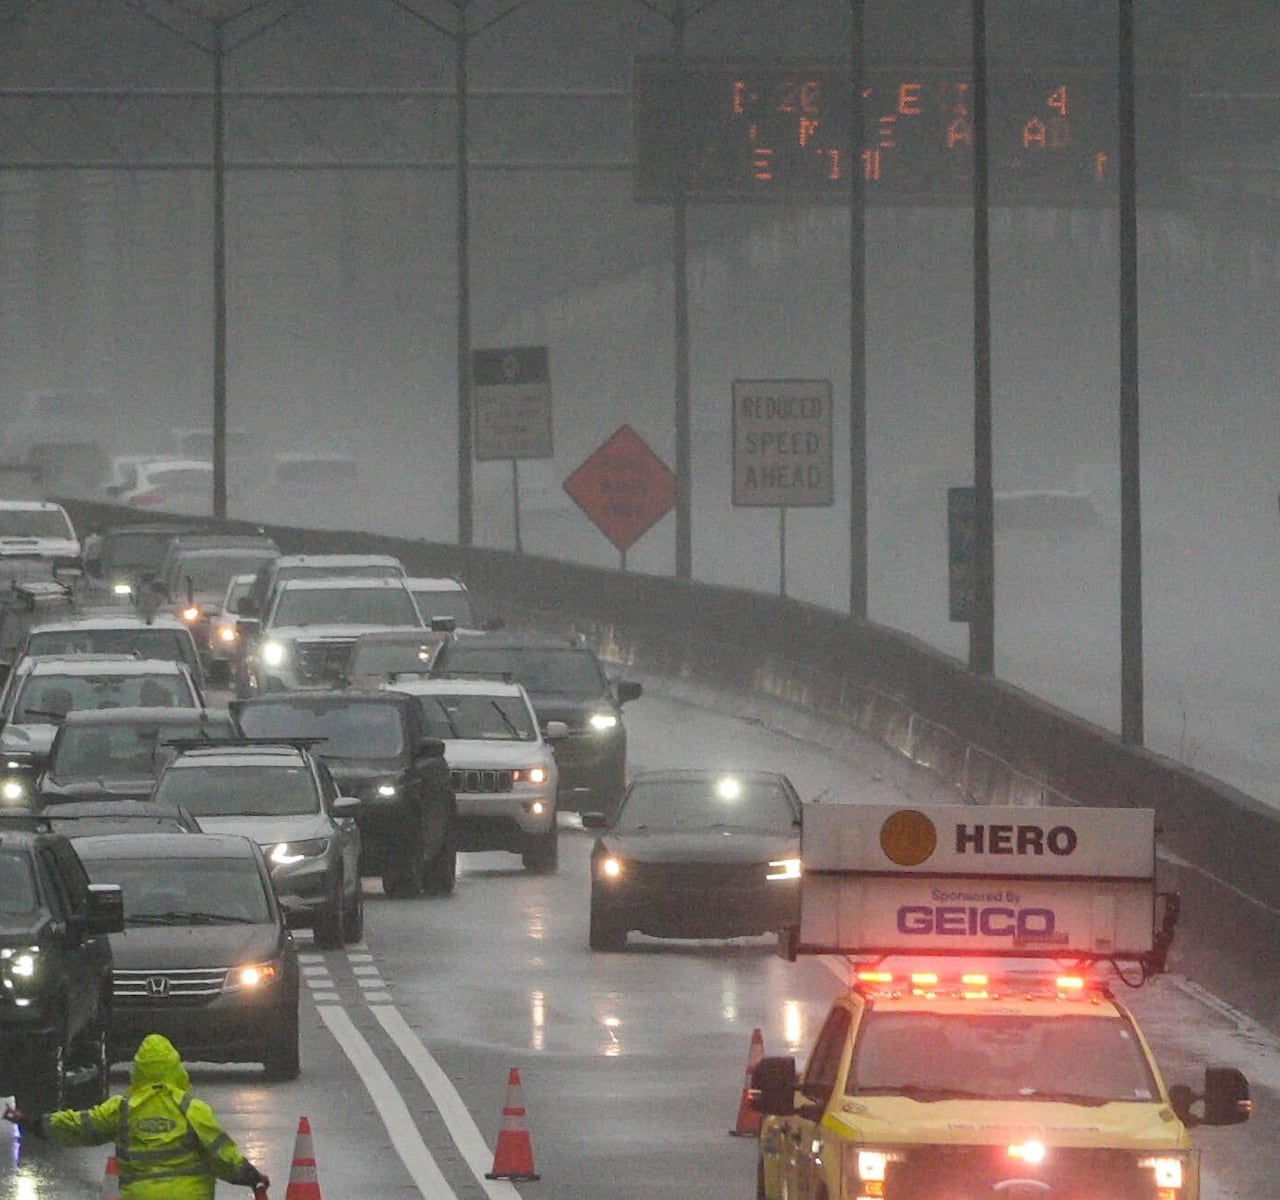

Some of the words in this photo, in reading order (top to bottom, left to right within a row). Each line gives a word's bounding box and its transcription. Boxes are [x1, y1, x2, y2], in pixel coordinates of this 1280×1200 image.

[742, 396, 822, 420] REDUCED
[745, 431, 819, 455] SPEED
[744, 464, 822, 489] AHEAD
[955, 823, 1078, 857] HERO
[931, 888, 1002, 904] Sponsored
[896, 905, 1056, 937] GEICO
